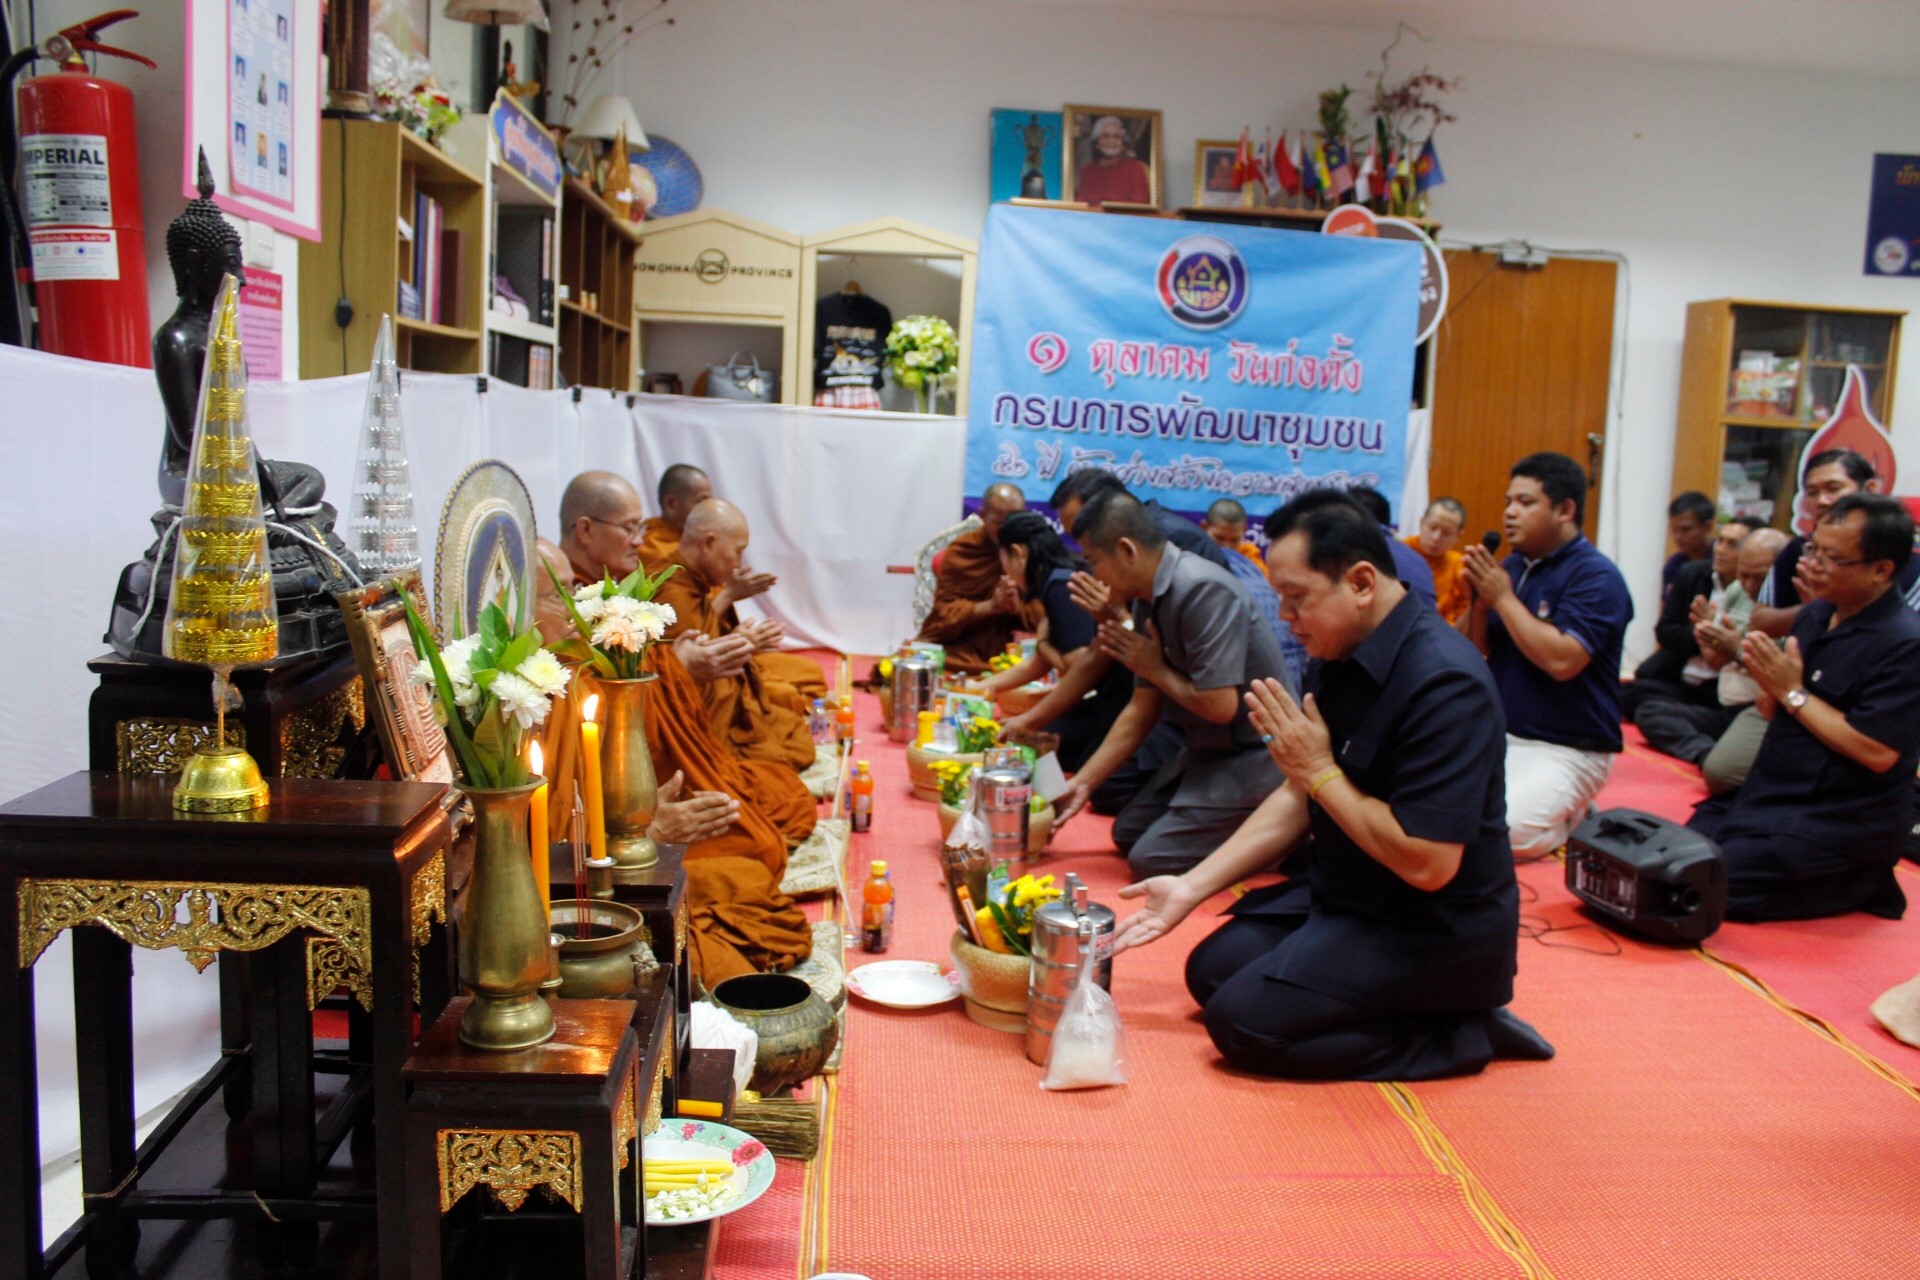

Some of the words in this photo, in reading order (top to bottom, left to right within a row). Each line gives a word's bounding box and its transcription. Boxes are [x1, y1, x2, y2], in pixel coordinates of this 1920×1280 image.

[730, 265, 794, 279] PROVINCE
[1027, 331, 1069, 374] ๑
[1090, 339, 1209, 389] ตุลาคม
[1228, 334, 1364, 393] วันก่อตั้ง
[993, 392, 1384, 461] กรมการพัฒนาชุมชน
[1034, 439, 1065, 480] ปี
